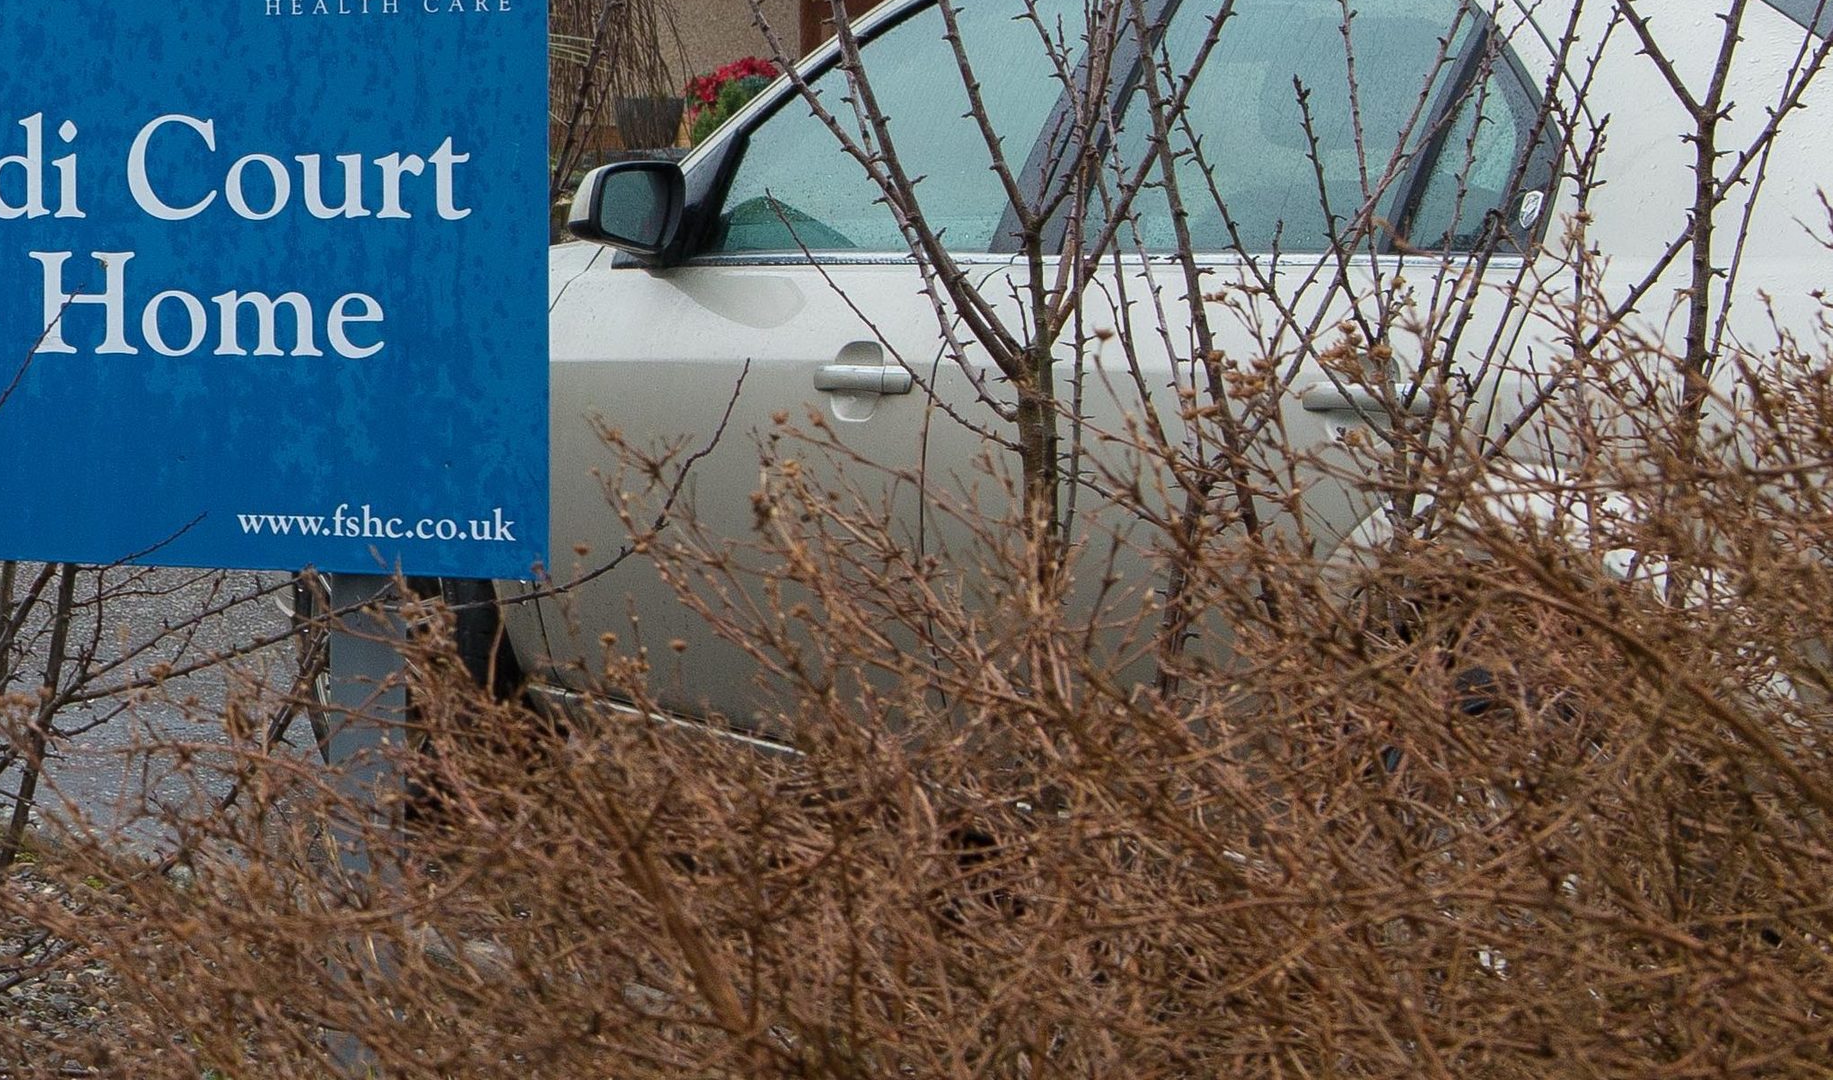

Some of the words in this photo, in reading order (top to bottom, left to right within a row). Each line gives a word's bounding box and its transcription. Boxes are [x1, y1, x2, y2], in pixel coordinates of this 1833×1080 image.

[127, 114, 472, 221] Court
[28, 251, 386, 359] Home
[237, 503, 516, 542] www.fshc.co.uk
